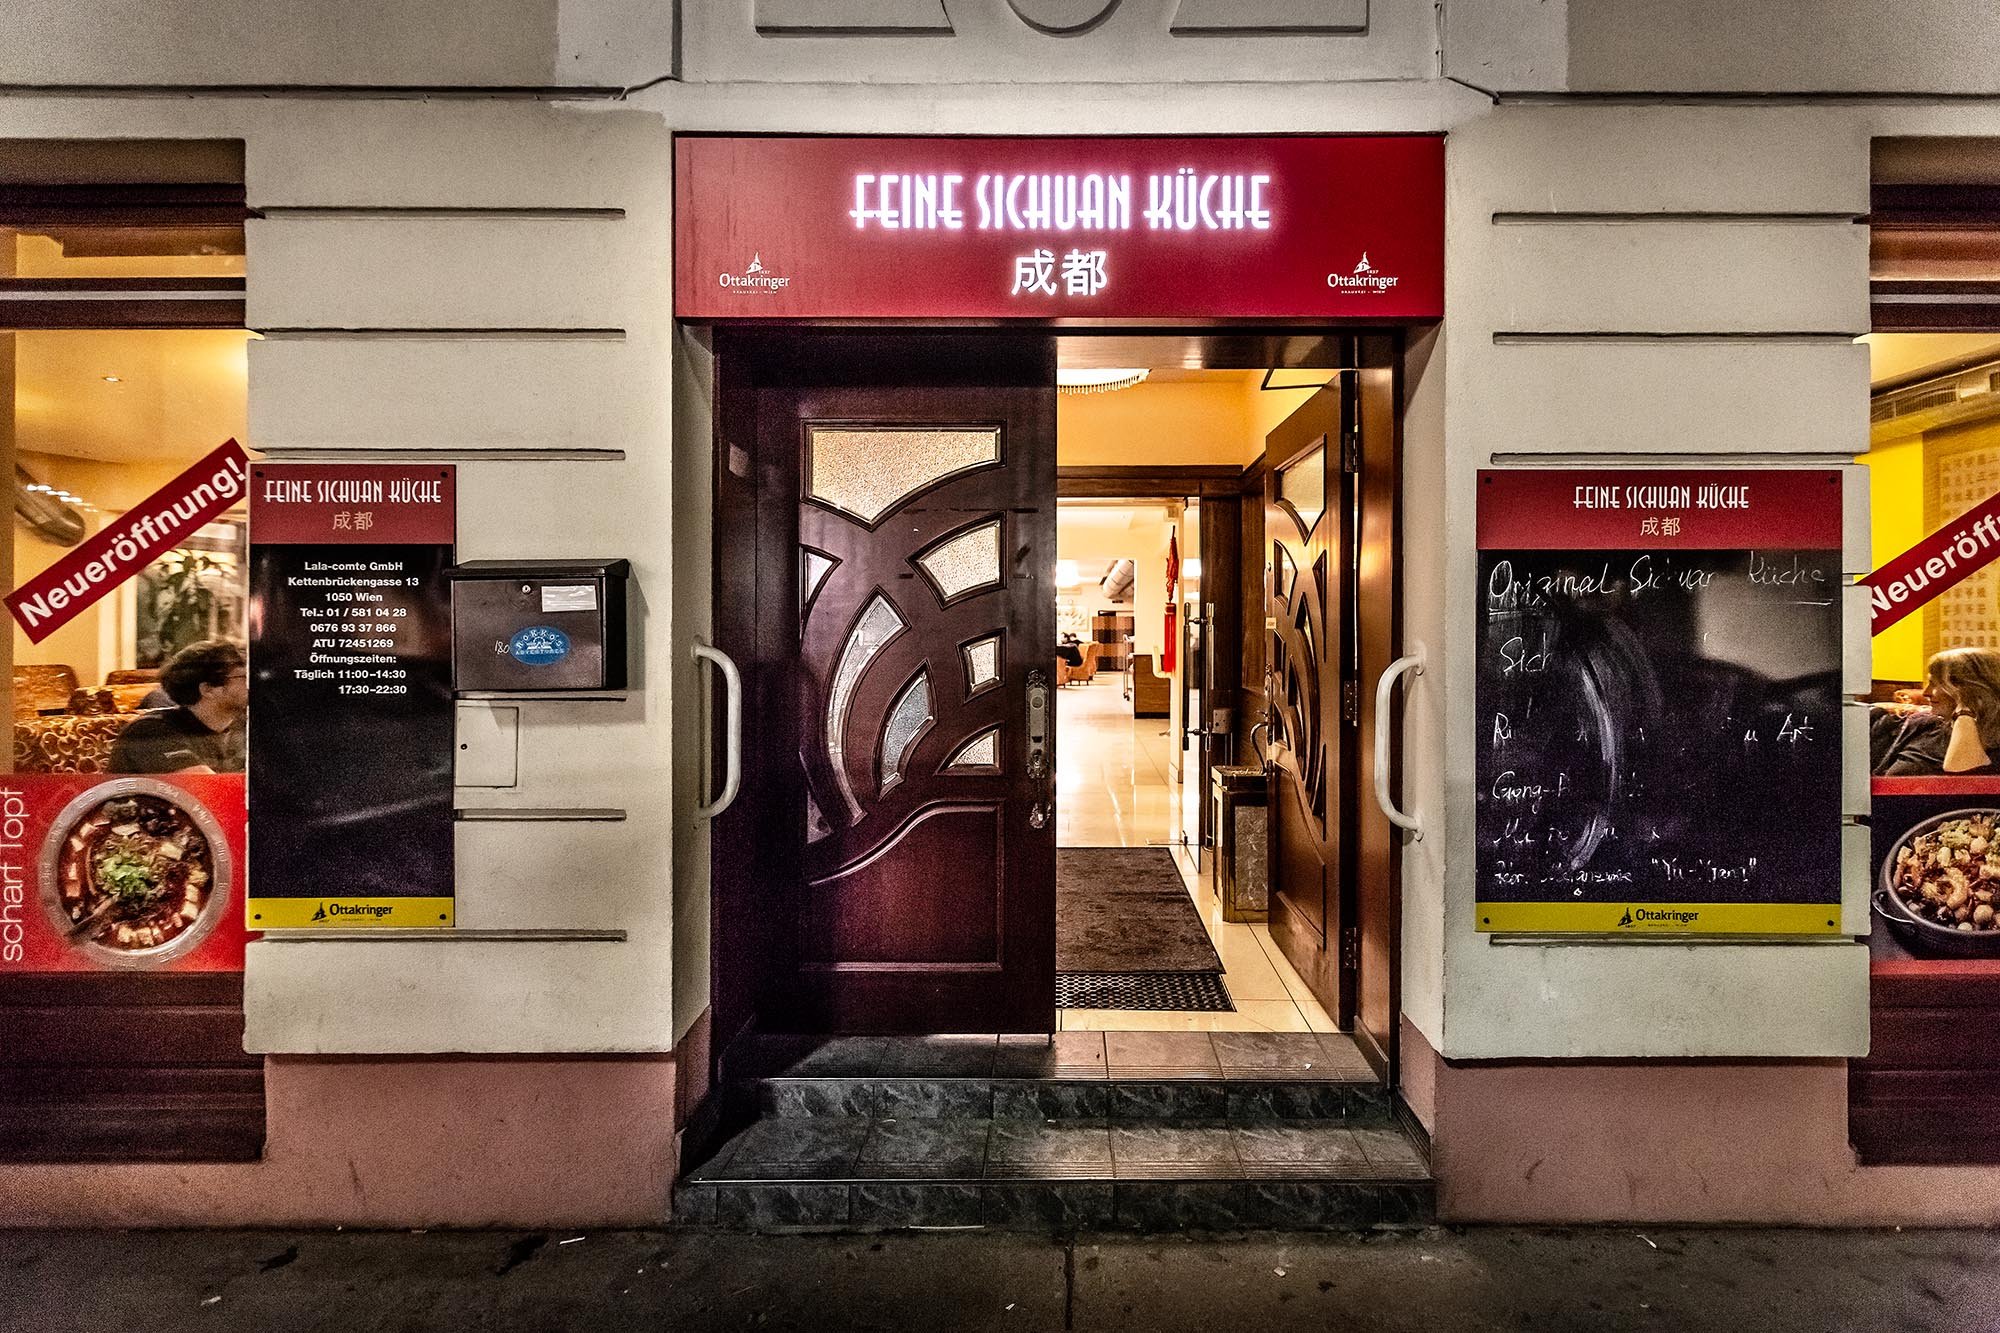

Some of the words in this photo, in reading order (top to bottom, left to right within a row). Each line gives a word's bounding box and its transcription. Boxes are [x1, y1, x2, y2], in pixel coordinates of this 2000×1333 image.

[849, 174, 963, 230] FEINE
[976, 174, 1131, 230] SICHUAN
[1143, 168, 1270, 231] KÜCHE
[1011, 248, 1108, 296] 成都
[719, 273, 790, 290] Ottakringer
[1327, 273, 1399, 290] Ottakringer
[263, 480, 312, 503] FEINE
[317, 480, 382, 503] SICHUAN
[388, 478, 442, 503] KÜCHE
[1572, 486, 1620, 508] FEINE
[1626, 486, 1690, 509] SICHUAN
[1695, 484, 1749, 509] KÜCHE
[332, 511, 373, 531] 成都
[1639, 517, 1681, 537] 成都
[18, 456, 248, 628] Neueröffnung!
[304, 561, 367, 571] Lala-comte
[369, 561, 403, 571] GmbH
[1872, 514, 2000, 620] Neueröff
[288, 576, 402, 588] Kettenbrückengasse
[405, 577, 419, 586] 13
[325, 592, 353, 602] 1050
[355, 592, 383, 602] Wien
[300, 607, 324, 617] Tel.:
[326, 607, 340, 617] 01
[343, 607, 349, 617] /
[351, 607, 372, 617] 581
[375, 607, 390, 617] 04
[392, 607, 407, 617] 28
[310, 623, 339, 633] 0676
[341, 623, 356, 633] 93
[358, 623, 373, 633] 37
[375, 623, 397, 633] 866
[312, 638, 336, 648] ATU
[338, 638, 394, 648] 72451269
[309, 652, 397, 665] Öffnungszeiten:
[293, 669, 335, 681] Täglich
[0, 787, 31, 855] Topf
[329, 903, 394, 918] Ottakringer
[1635, 908, 1700, 923] Ottakringer
